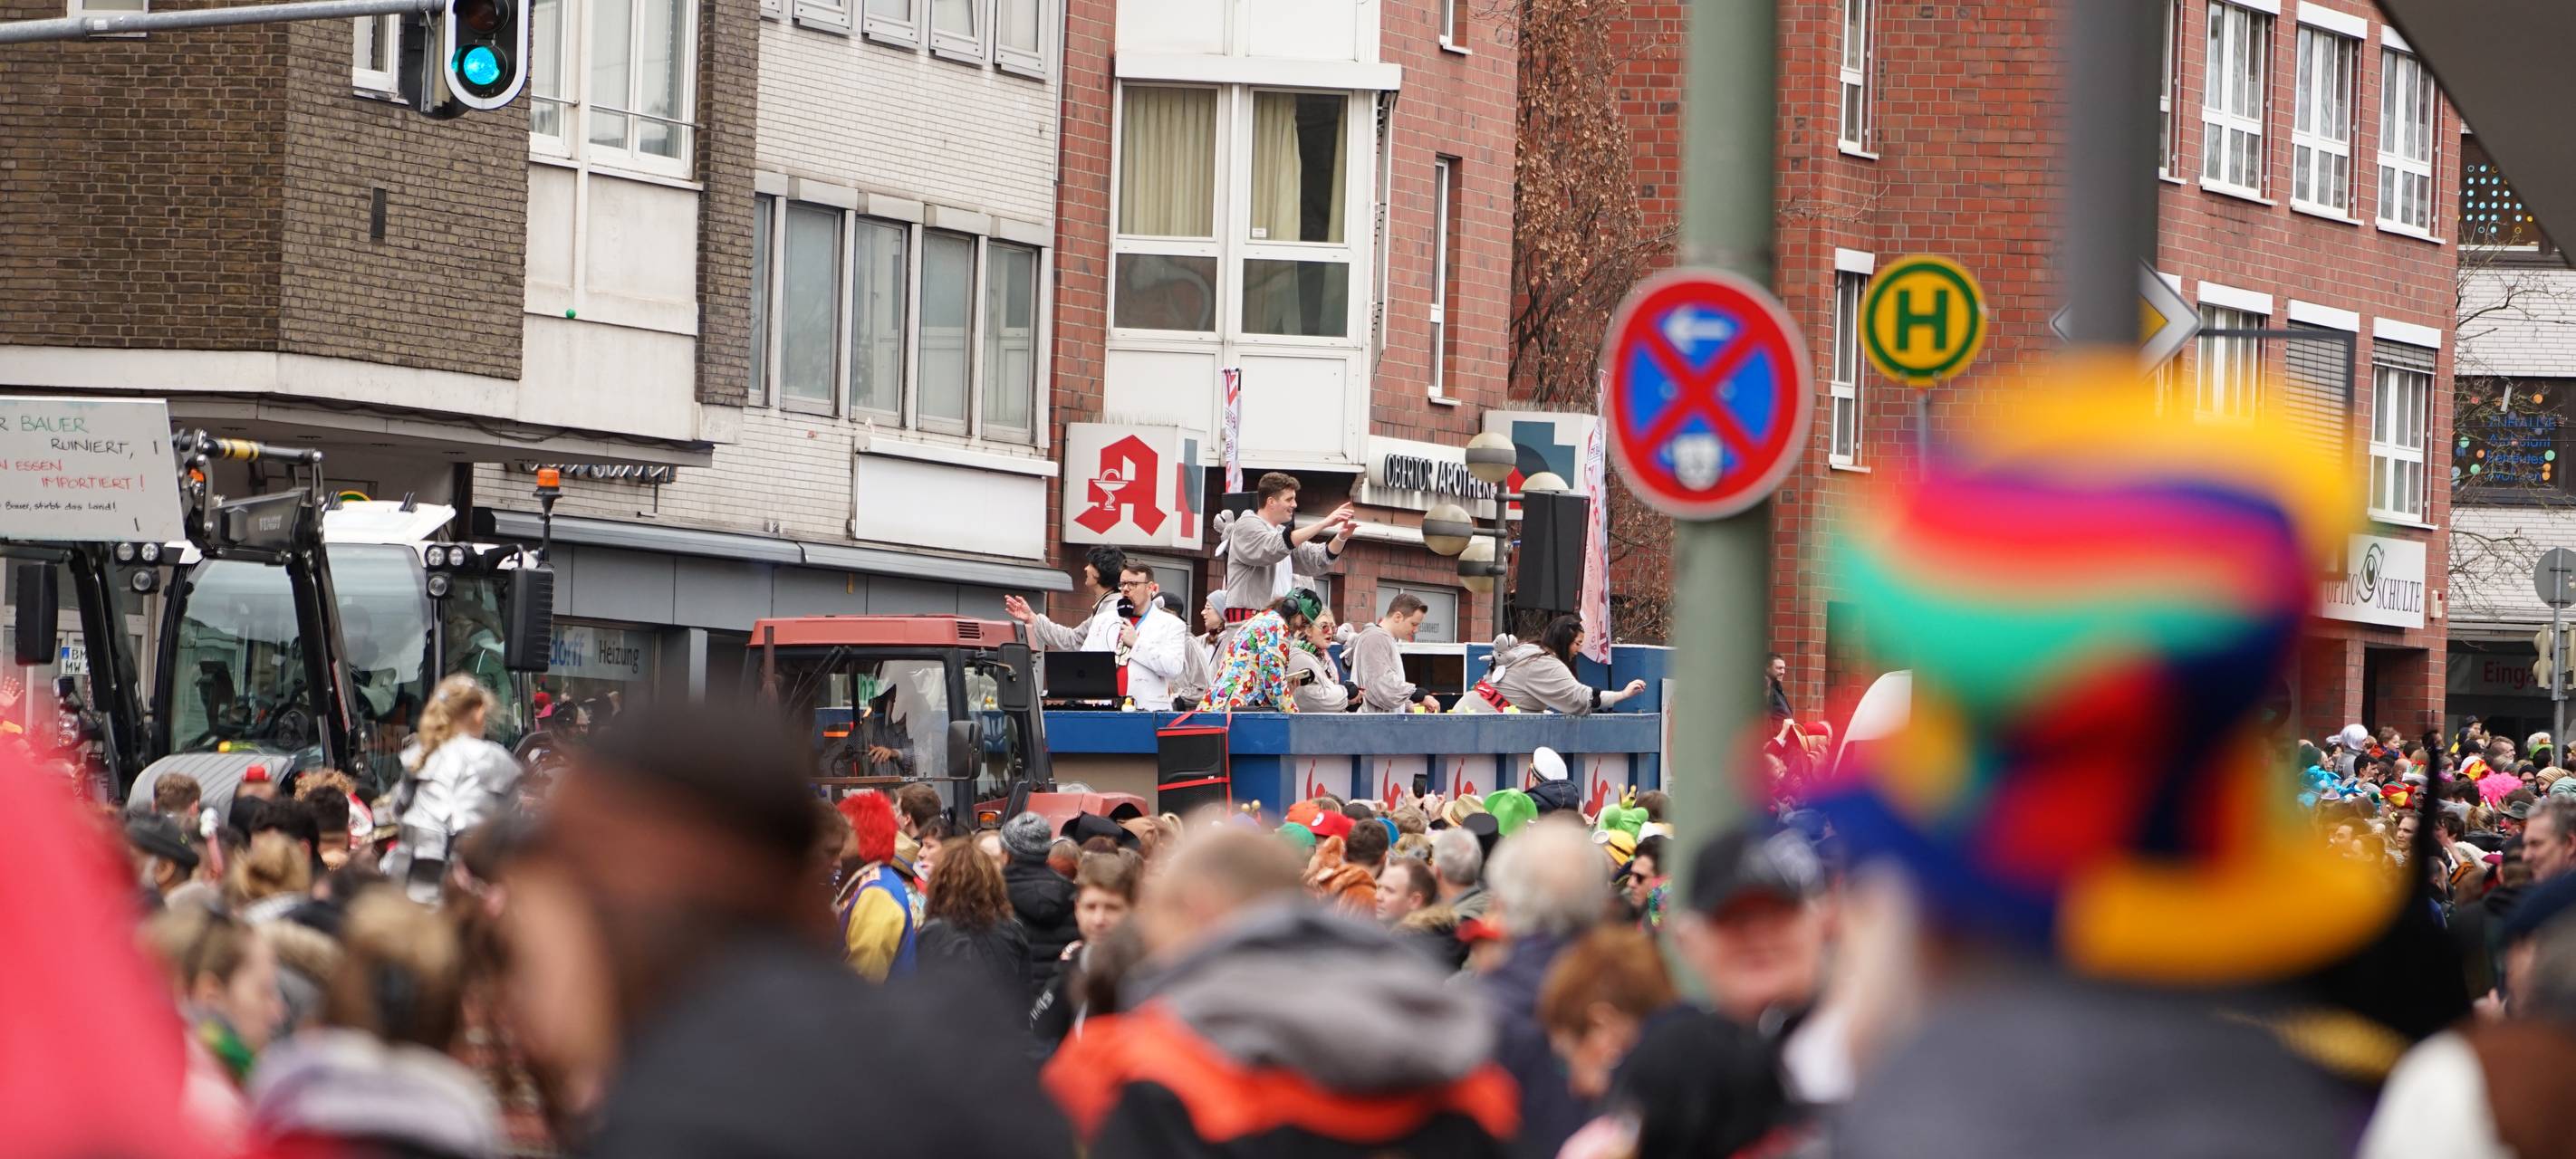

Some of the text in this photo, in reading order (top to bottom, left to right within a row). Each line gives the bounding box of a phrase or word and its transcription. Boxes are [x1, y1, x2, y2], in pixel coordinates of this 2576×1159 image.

[1896, 289, 1949, 351] H
[21, 416, 90, 434] BAUER
[51, 438, 134, 460] RUINIERT,
[15, 459, 62, 472] ESSEN
[1384, 453, 1433, 492] OBERTOR
[64, 502, 83, 511] das
[2325, 572, 2422, 613] OPTIC SCHULTE
[599, 639, 639, 674] Heizung
